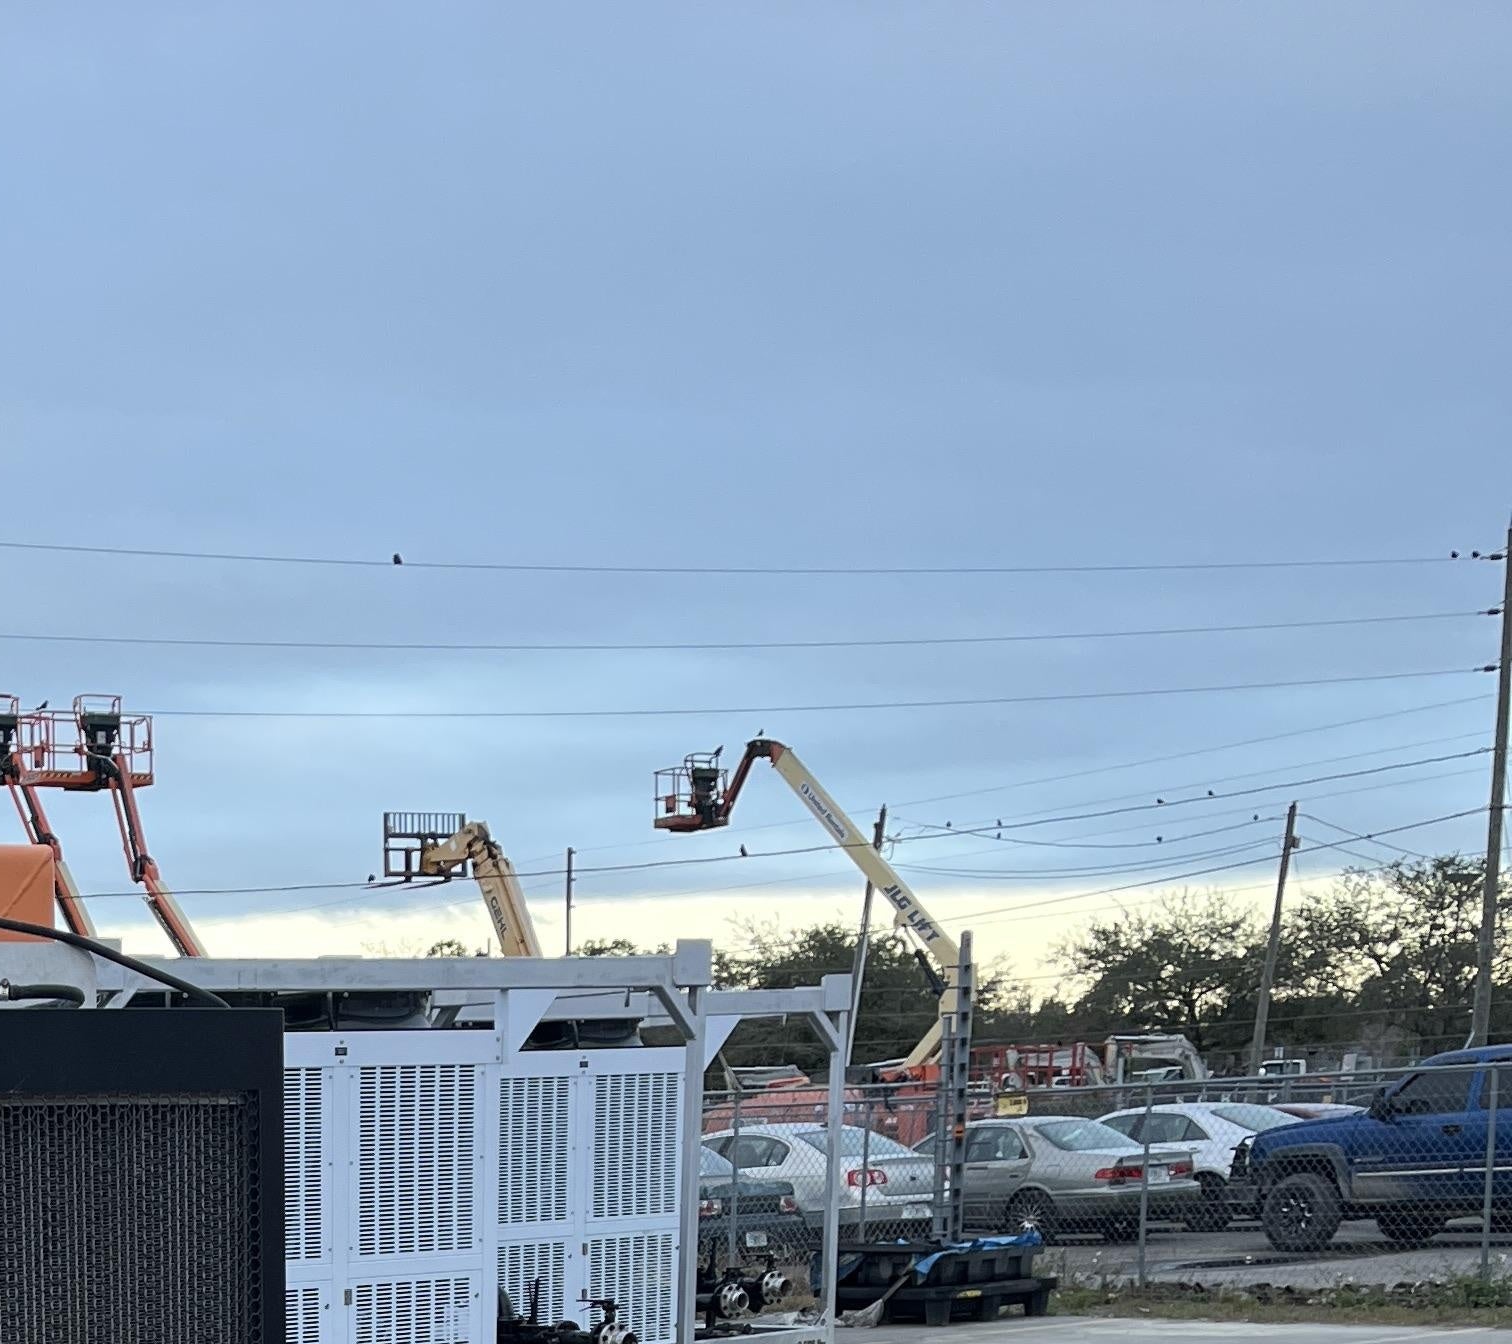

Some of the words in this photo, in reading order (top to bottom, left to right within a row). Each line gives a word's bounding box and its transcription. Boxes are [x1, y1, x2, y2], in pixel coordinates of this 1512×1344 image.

[490, 895, 508, 941] GEHL
[884, 884, 912, 910] JLG
[907, 909, 940, 942] LIFT
